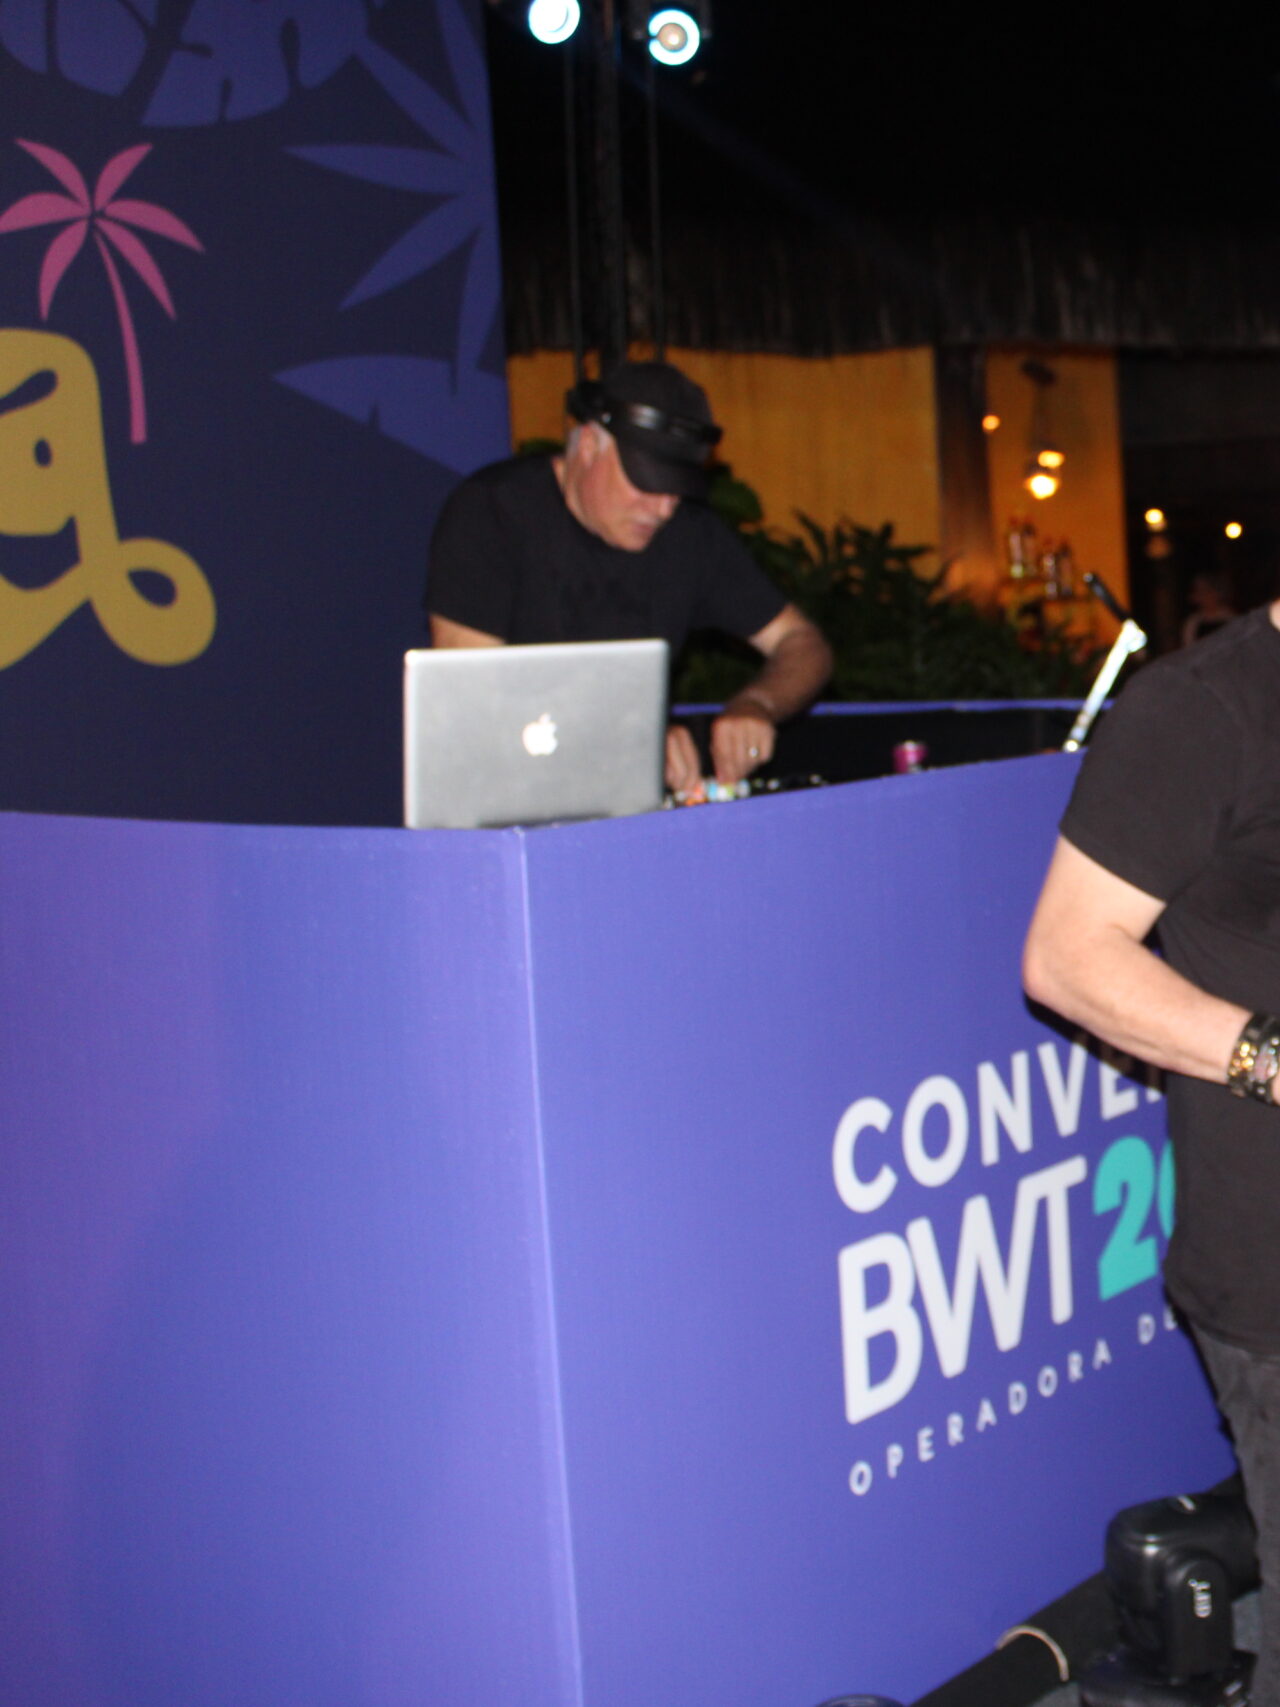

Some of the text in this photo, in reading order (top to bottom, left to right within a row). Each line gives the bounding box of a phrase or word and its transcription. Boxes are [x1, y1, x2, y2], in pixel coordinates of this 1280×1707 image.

[832, 1038, 1163, 1214] CONVE
[838, 1155, 1088, 1425] BWT
[848, 1337, 1112, 1496] OPERADORA
